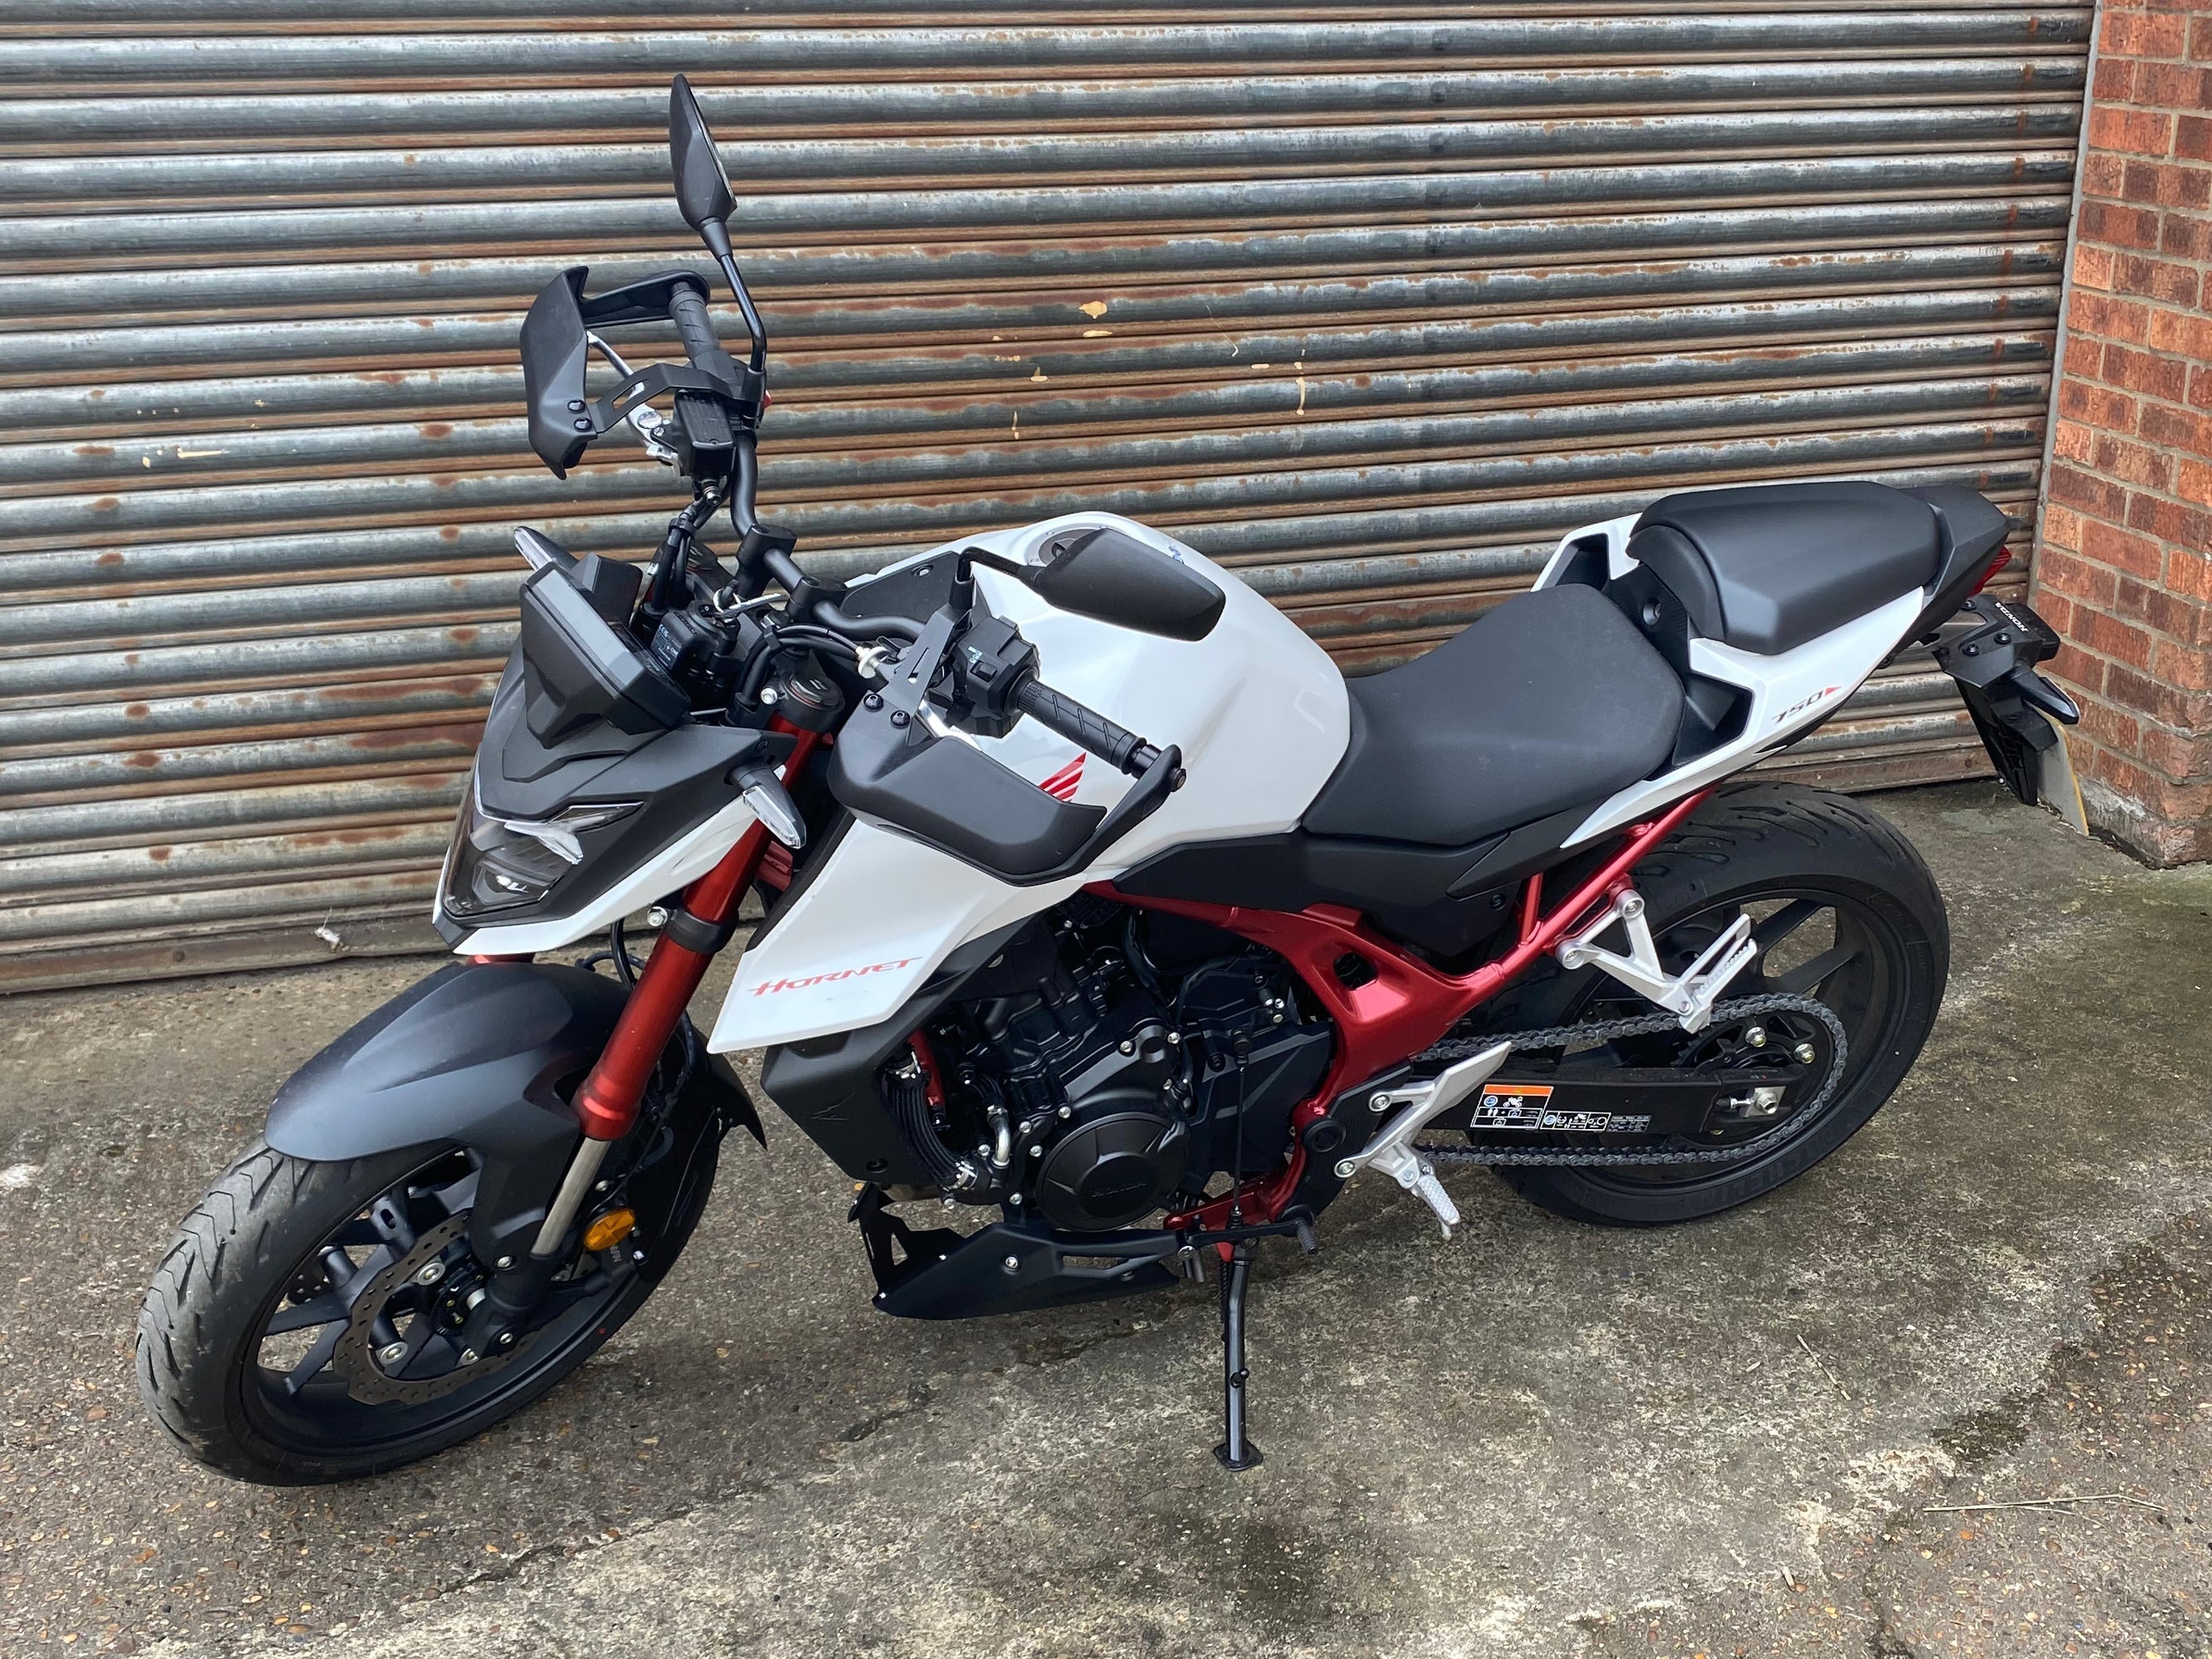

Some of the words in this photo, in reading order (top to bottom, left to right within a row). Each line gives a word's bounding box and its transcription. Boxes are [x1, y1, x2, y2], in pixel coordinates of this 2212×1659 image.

[1995, 601, 2029, 632] HONDA
[1771, 689, 1824, 724] 750
[747, 956, 923, 997] HORNET
